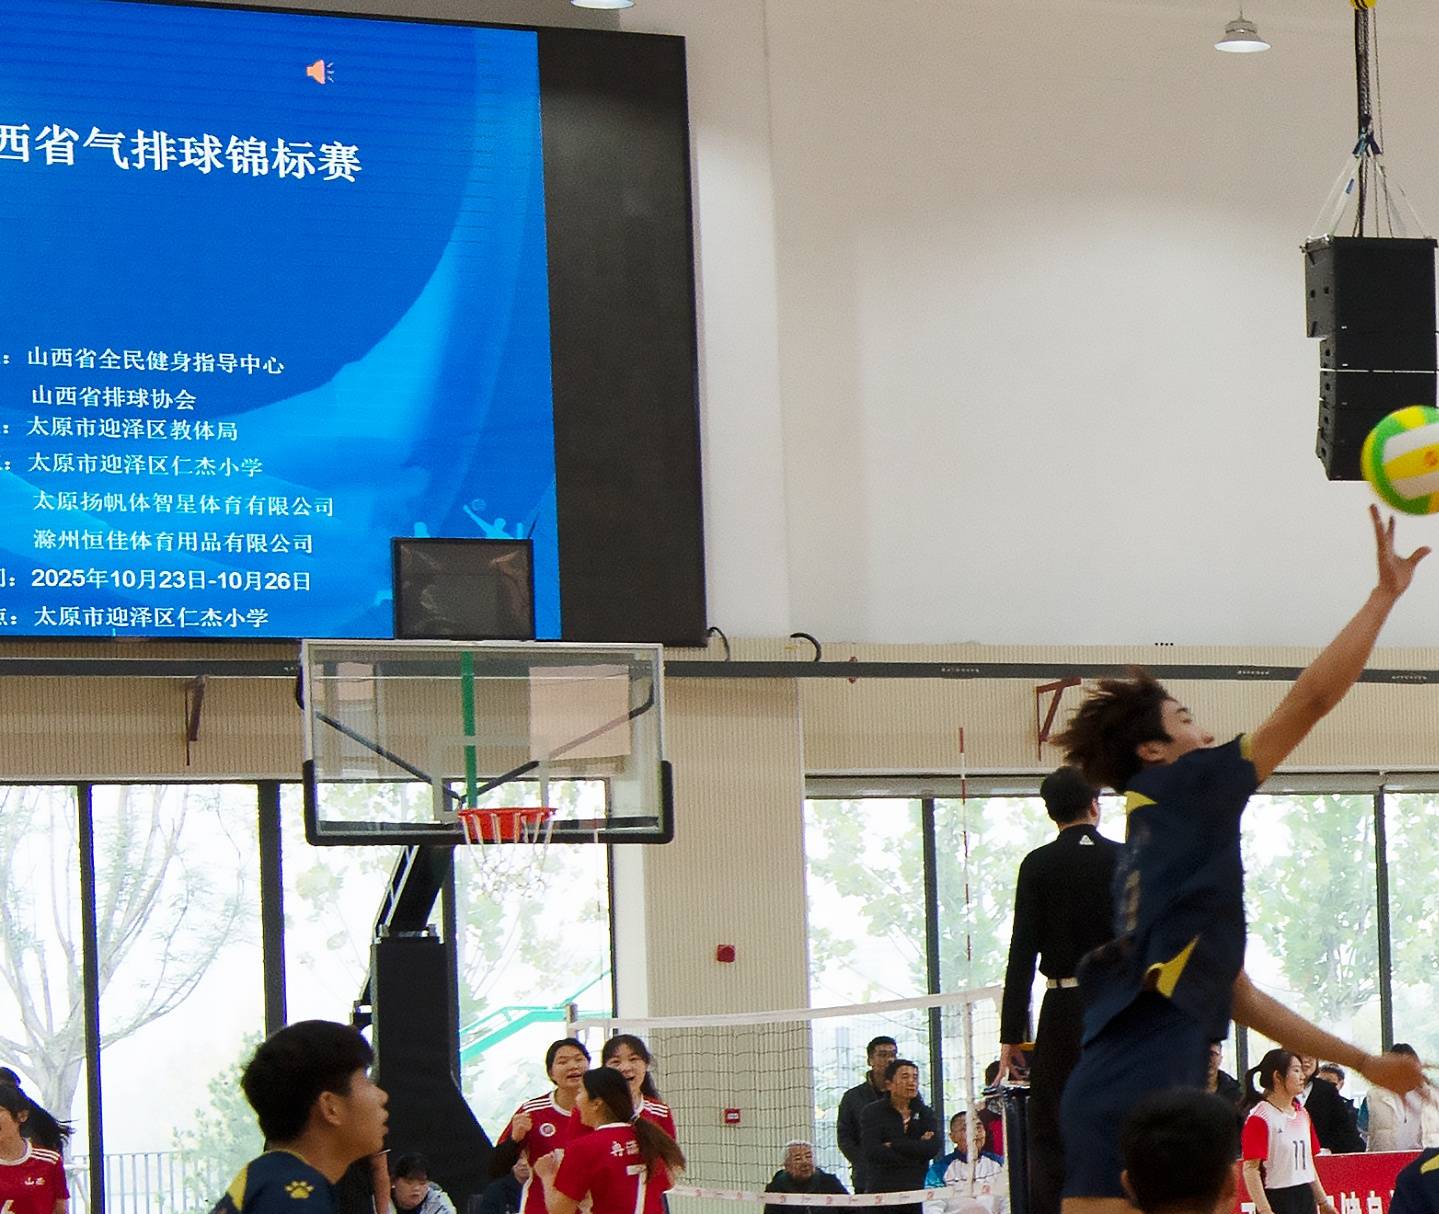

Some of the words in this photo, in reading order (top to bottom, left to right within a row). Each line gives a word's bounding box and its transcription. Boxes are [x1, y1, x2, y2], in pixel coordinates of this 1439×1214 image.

[0, 123, 362, 183] 西省气排球锦标赛
[32, 384, 197, 411] 山西省排球协会
[33, 491, 335, 517] 太原扬帆体智星体育有限公司
[33, 528, 314, 554] 滁州恒佳体育用品有限公司
[1292, 1139, 1306, 1171] 11
